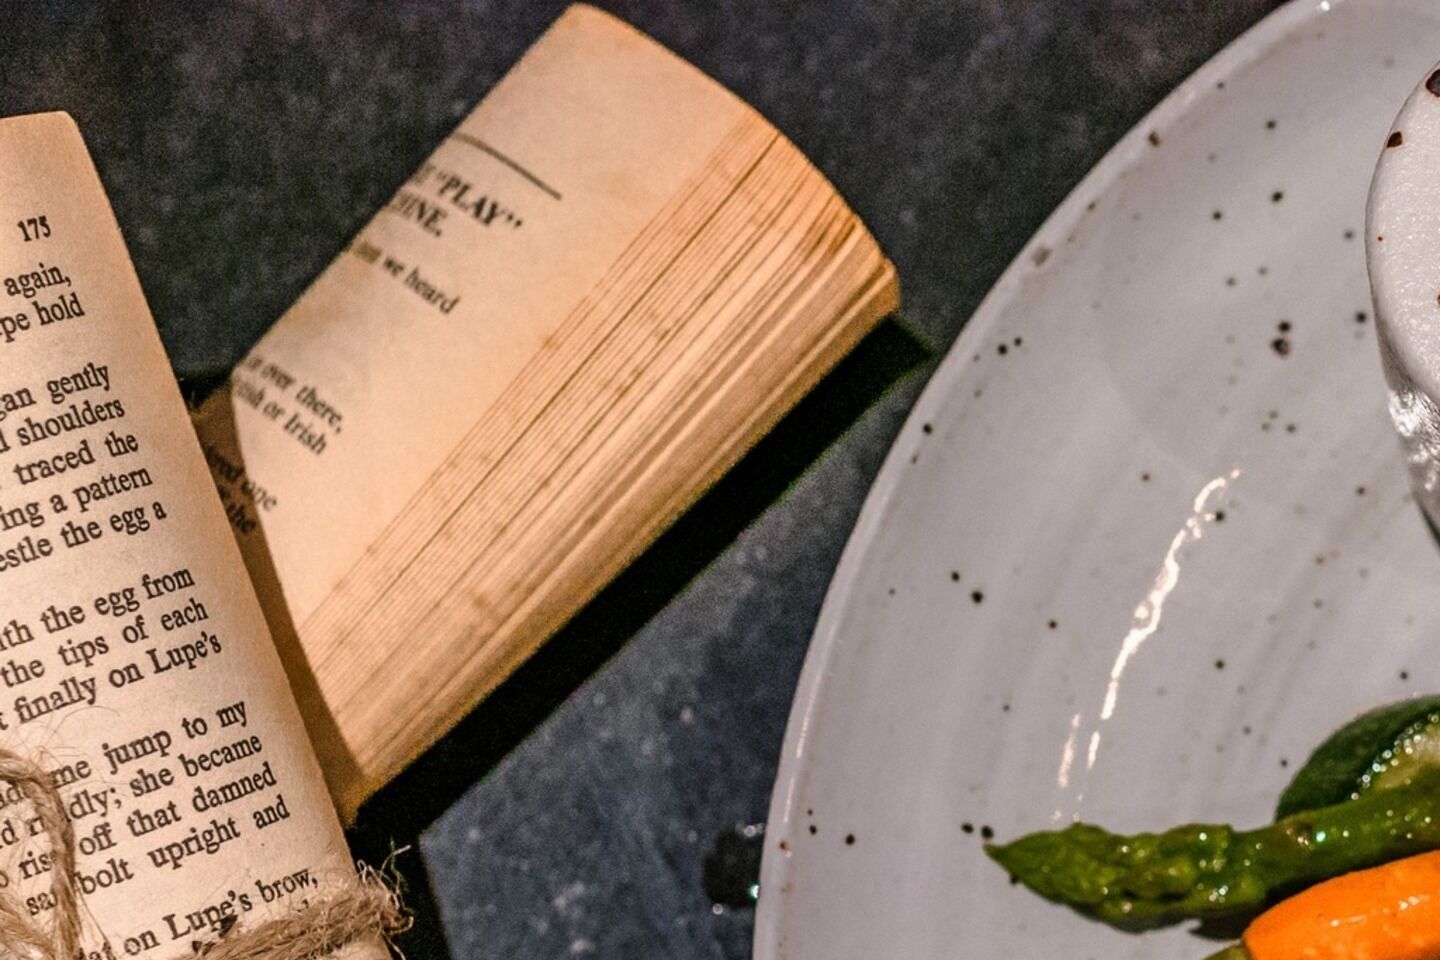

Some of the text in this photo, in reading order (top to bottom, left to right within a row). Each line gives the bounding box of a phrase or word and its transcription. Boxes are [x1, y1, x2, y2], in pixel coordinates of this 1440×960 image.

[17, 215, 51, 242] 175
[4, 262, 71, 298] again,
[404, 266, 460, 314] heard
[0, 292, 85, 343] pe hold
[47, 362, 110, 404] gently
[17, 399, 125, 446] shoulders
[283, 413, 327, 455] Irish
[296, 385, 342, 434] there,
[13, 439, 95, 485] traced
[104, 431, 139, 457] the
[50, 494, 68, 513] a
[72, 467, 153, 513] pattern
[60, 520, 102, 548] the
[110, 506, 150, 535] egg
[152, 501, 167, 520] a
[40, 605, 86, 634] the
[94, 586, 140, 617] egg
[142, 568, 195, 600] from
[1, 597, 209, 688] the tips of each
[14, 675, 96, 725] finally
[109, 662, 145, 688] on
[102, 730, 172, 775] jump
[181, 717, 208, 739] to
[215, 701, 246, 727] my
[130, 767, 174, 797] she
[178, 735, 262, 777] became
[79, 821, 117, 856] off
[126, 800, 182, 837] that
[192, 761, 277, 813] damned
[77, 857, 134, 895] bolt
[147, 817, 240, 870] upright
[253, 794, 290, 829] and
[123, 929, 160, 957] on
[255, 867, 320, 903] brow,
